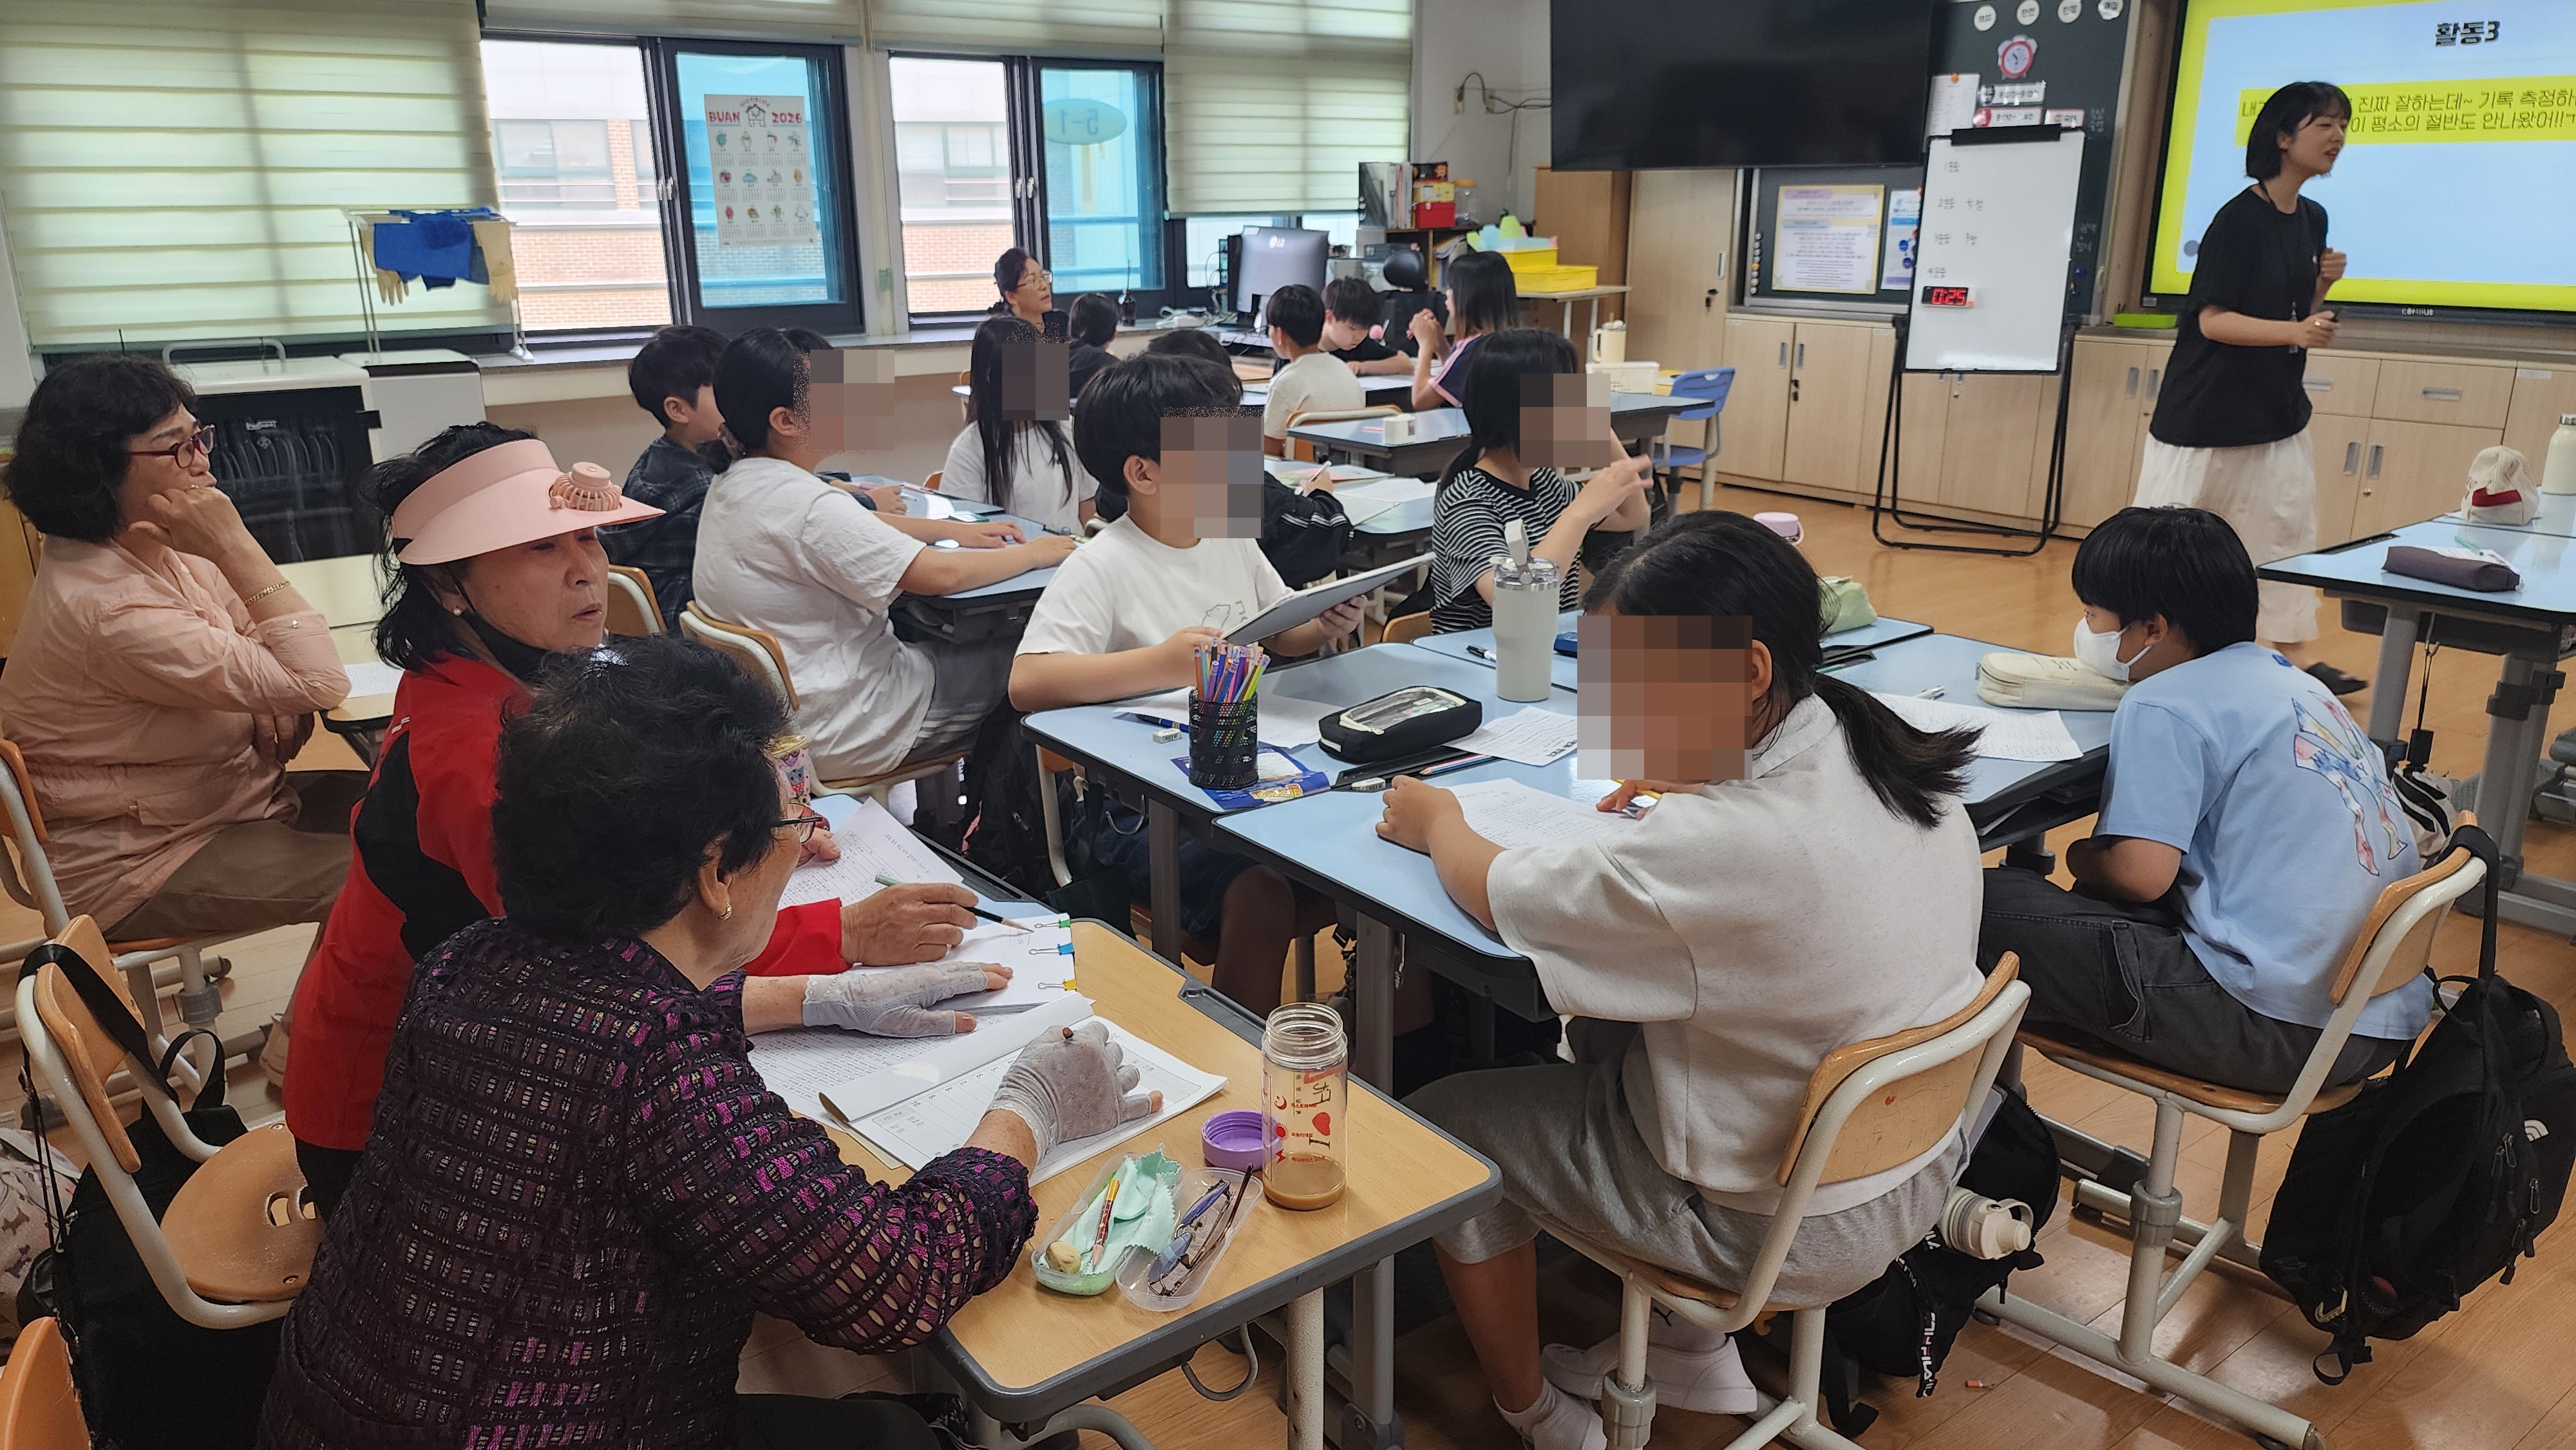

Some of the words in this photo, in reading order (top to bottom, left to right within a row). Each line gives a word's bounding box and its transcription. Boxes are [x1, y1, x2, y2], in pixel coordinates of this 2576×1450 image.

[2435, 21, 2501, 46] 활동3
[2241, 100, 2266, 117] 내
[2358, 95, 2389, 113] 진짜
[2396, 91, 2473, 112] 잘하는데~
[2479, 90, 2514, 109] 기록
[2520, 88, 2576, 108] 측정하
[709, 111, 741, 123] BUAN
[772, 112, 803, 124] 2026
[2372, 114, 2420, 133] 평소의
[2426, 113, 2479, 131] 절반도
